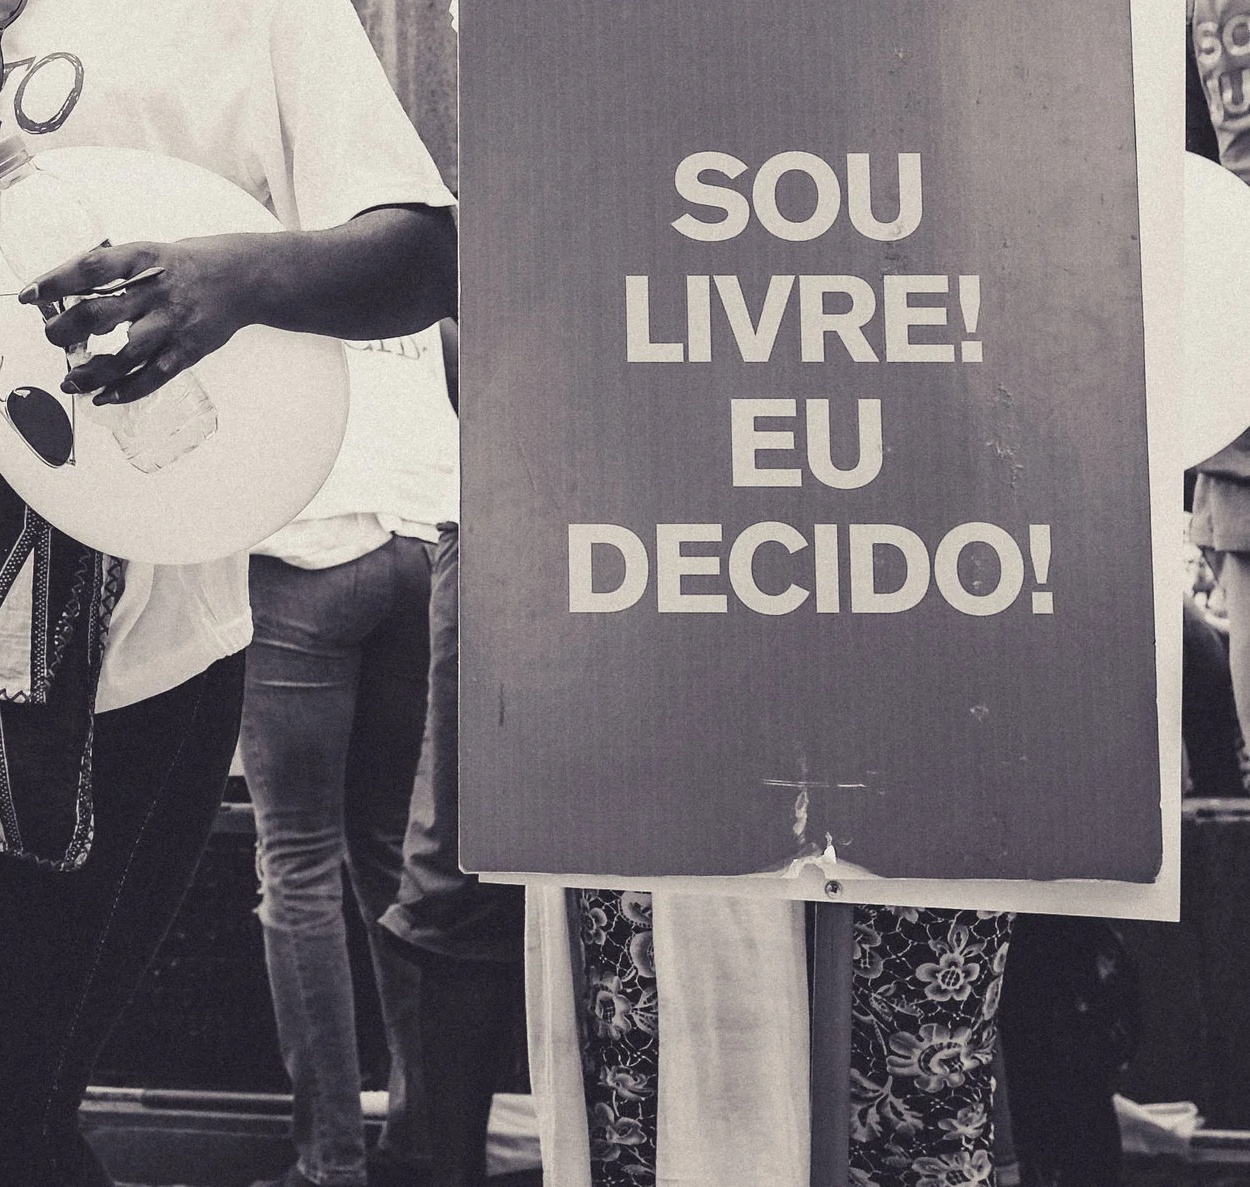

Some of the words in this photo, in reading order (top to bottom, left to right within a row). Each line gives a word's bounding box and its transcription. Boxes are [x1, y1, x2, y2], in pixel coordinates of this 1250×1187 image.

[670, 150, 923, 243] SOU
[624, 274, 984, 364] LIVRE!
[730, 398, 884, 490] EU
[567, 521, 1054, 617] DECIDO!
